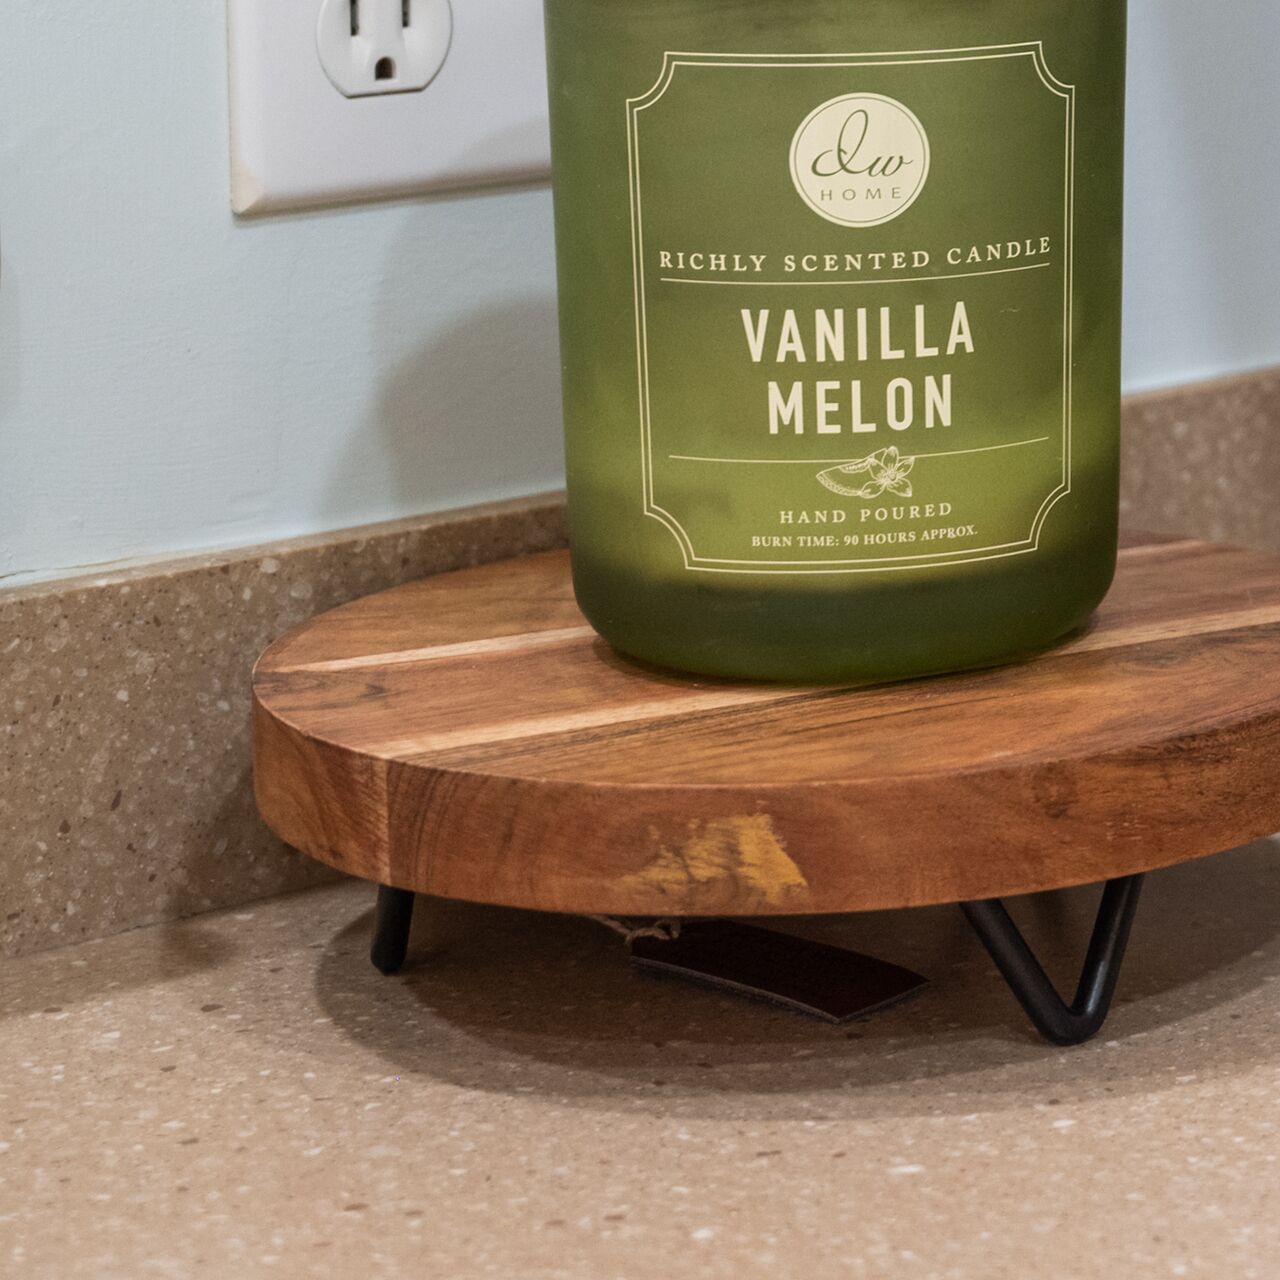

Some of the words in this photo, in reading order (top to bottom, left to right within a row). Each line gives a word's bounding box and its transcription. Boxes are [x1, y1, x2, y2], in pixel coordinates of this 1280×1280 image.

[820, 186, 902, 202] HOME
[659, 250, 767, 273] RICHLY
[784, 250, 931, 272] SCENTED
[946, 235, 1051, 265] CANDLE
[740, 300, 975, 363] VANILLA
[767, 373, 952, 435] MELON
[779, 509, 846, 524] HAND
[860, 501, 952, 523] POURED
[751, 535, 793, 548] BURN
[796, 534, 840, 547] TIME:
[843, 534, 859, 546] 90
[863, 531, 916, 546] HOURS
[920, 524, 978, 541] APPROX.
